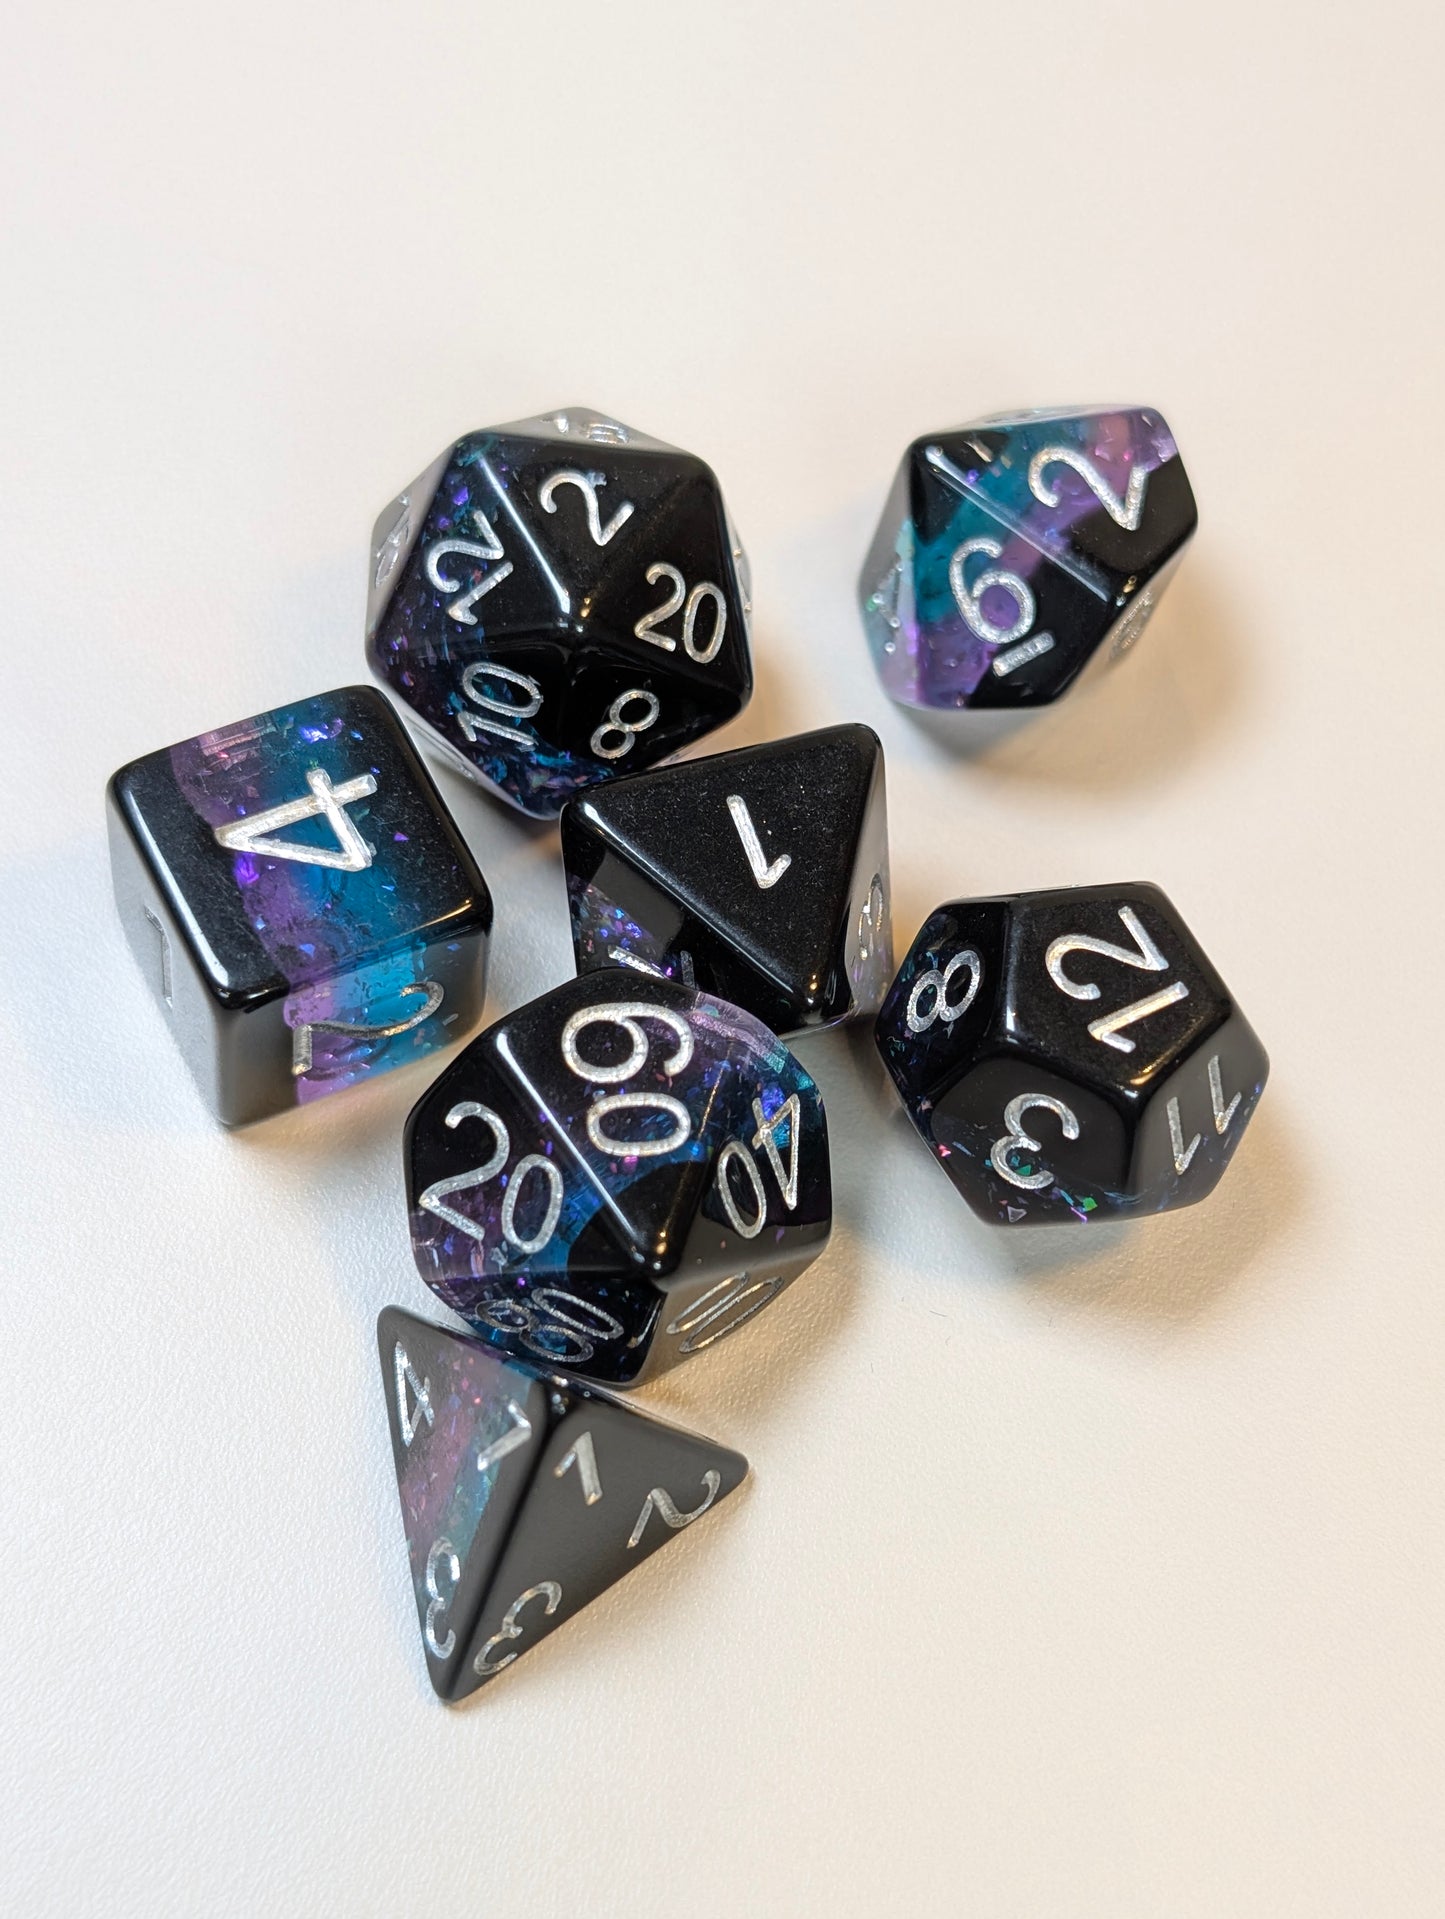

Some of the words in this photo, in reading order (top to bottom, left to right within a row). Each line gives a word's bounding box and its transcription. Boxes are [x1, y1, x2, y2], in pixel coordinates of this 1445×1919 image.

[540, 470, 635, 546] 2
[1028, 447, 1149, 531] 2
[426, 509, 514, 626] 12
[635, 562, 727, 664] 20
[949, 537, 1037, 645] 6
[456, 662, 543, 747] 10
[591, 689, 660, 759] 8
[215, 768, 377, 872] 4
[726, 795, 792, 889] 1
[906, 949, 981, 1033] 8
[1045, 906, 1190, 1054] 12
[292, 981, 445, 1077] 2
[990, 1093, 1080, 1190] 3
[1166, 1055, 1243, 1175] 11
[419, 1101, 564, 1254] 20
[717, 1093, 801, 1239] 40
[475, 1287, 624, 1362] 80
[394, 1341, 435, 1446] 4
[477, 1399, 533, 1471] 1
[554, 1431, 603, 1506] 1
[627, 1469, 721, 1549] 2
[425, 1537, 461, 1659] 3
[473, 1580, 563, 1675] 3
